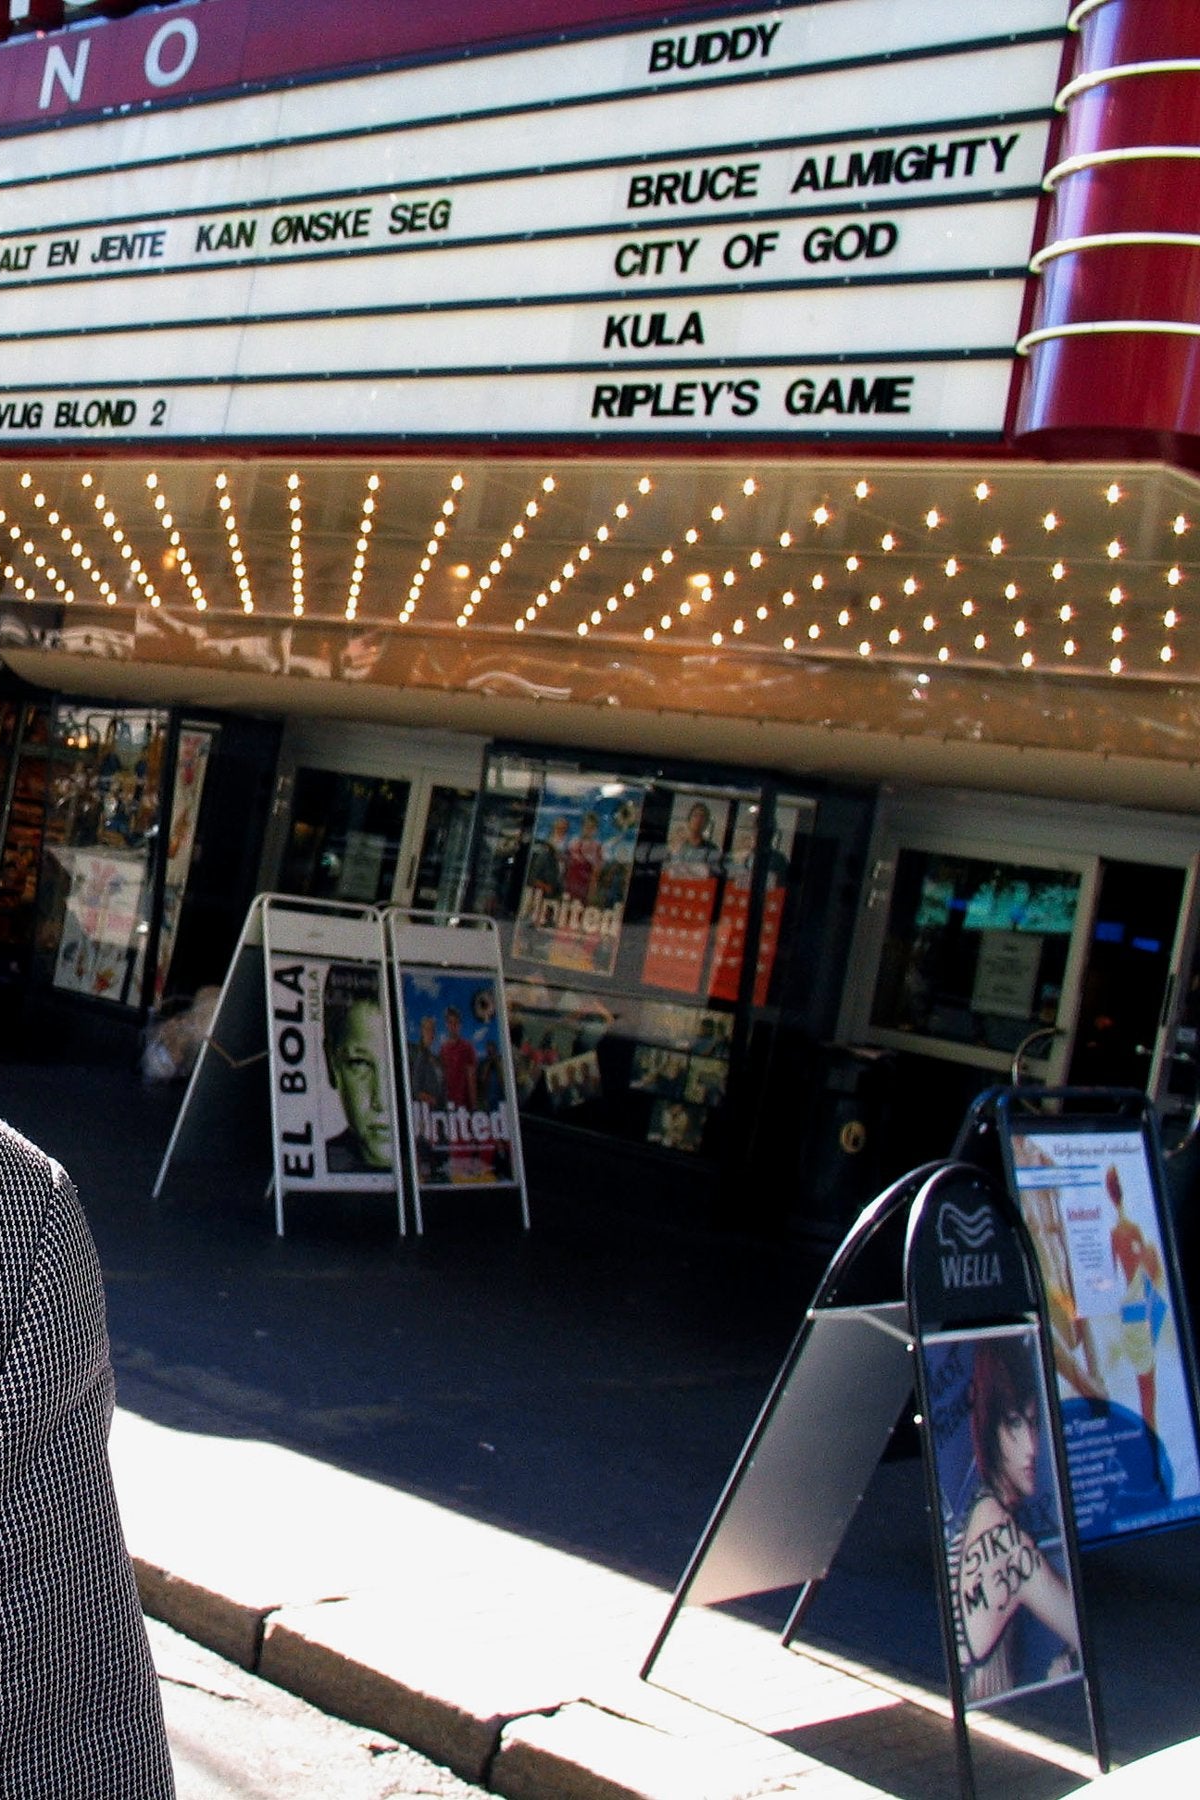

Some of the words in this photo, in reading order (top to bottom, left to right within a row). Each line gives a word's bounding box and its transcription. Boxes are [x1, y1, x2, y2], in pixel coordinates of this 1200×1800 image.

[649, 22, 782, 73] BUDDY
[627, 163, 760, 209] BRUCE
[791, 134, 1019, 194] ALMIGHTY
[47, 239, 80, 268] EN
[91, 230, 167, 264] JENTE
[195, 219, 258, 252] KAN
[270, 206, 373, 245] ØNSKE
[387, 199, 453, 235] SEG
[614, 238, 701, 278] CITY
[722, 231, 780, 270] OF
[802, 221, 900, 265] GOD
[602, 311, 706, 349] KULA
[54, 399, 137, 429] BLOND
[150, 398, 167, 427] 2
[591, 379, 761, 419] RIPLEY'S
[784, 376, 915, 416] GAME
[273, 965, 309, 1095] BOLA
[410, 1099, 511, 1143] United
[282, 1120, 316, 1179] EL
[940, 1251, 1004, 1289] WELLA
